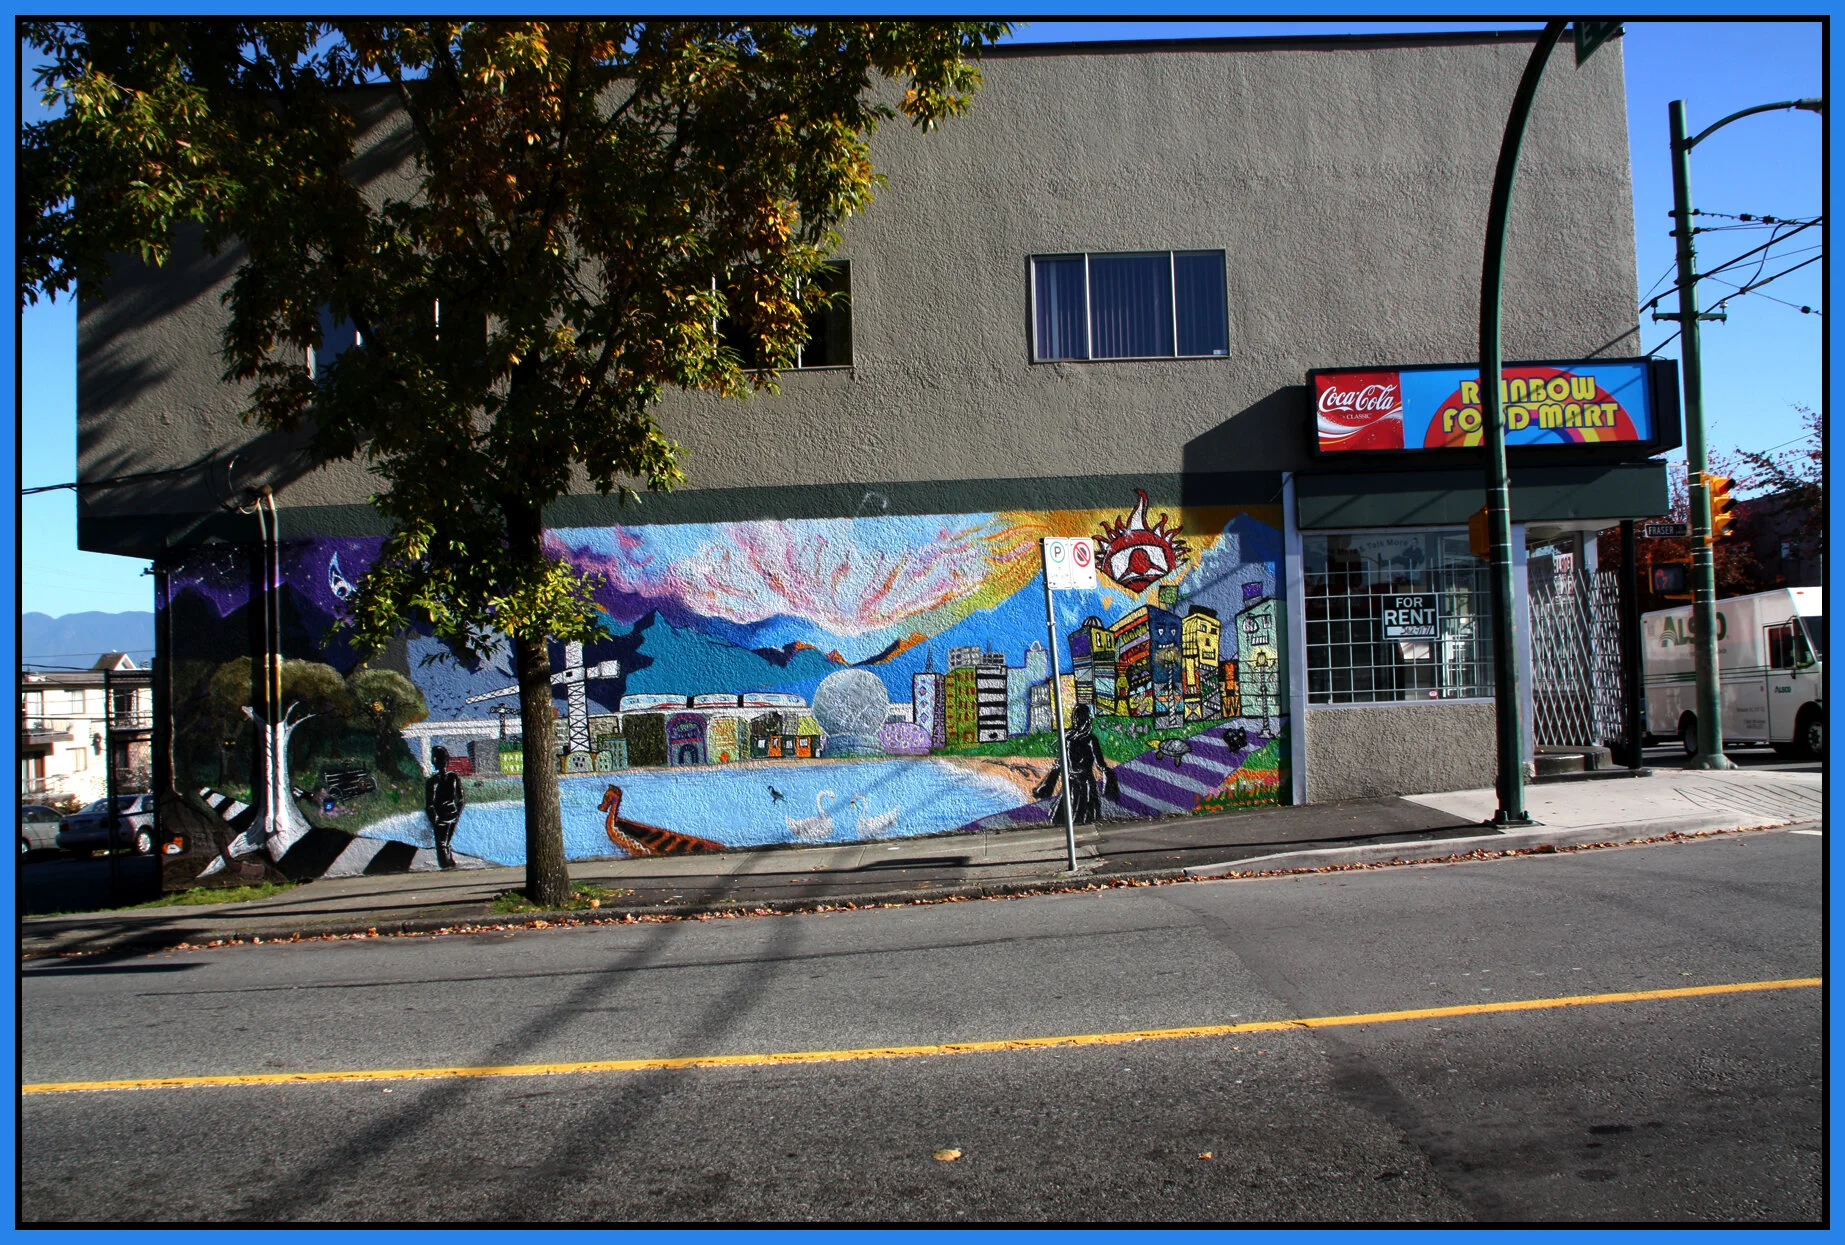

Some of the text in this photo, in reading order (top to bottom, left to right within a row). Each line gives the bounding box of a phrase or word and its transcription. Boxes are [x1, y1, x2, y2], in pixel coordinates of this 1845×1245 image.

[1318, 384, 1397, 412] Coca-Cola
[1460, 376, 1596, 405] RINBOW
[1443, 403, 1618, 432] FOD MART
[1648, 525, 1674, 535] FRASER
[1054, 546, 1061, 558] P
[1367, 539, 1385, 550] Talk
[1386, 538, 1408, 547] More
[1395, 597, 1423, 608] FOR
[1384, 608, 1435, 625] RENT
[1659, 611, 1727, 647] ALSO
